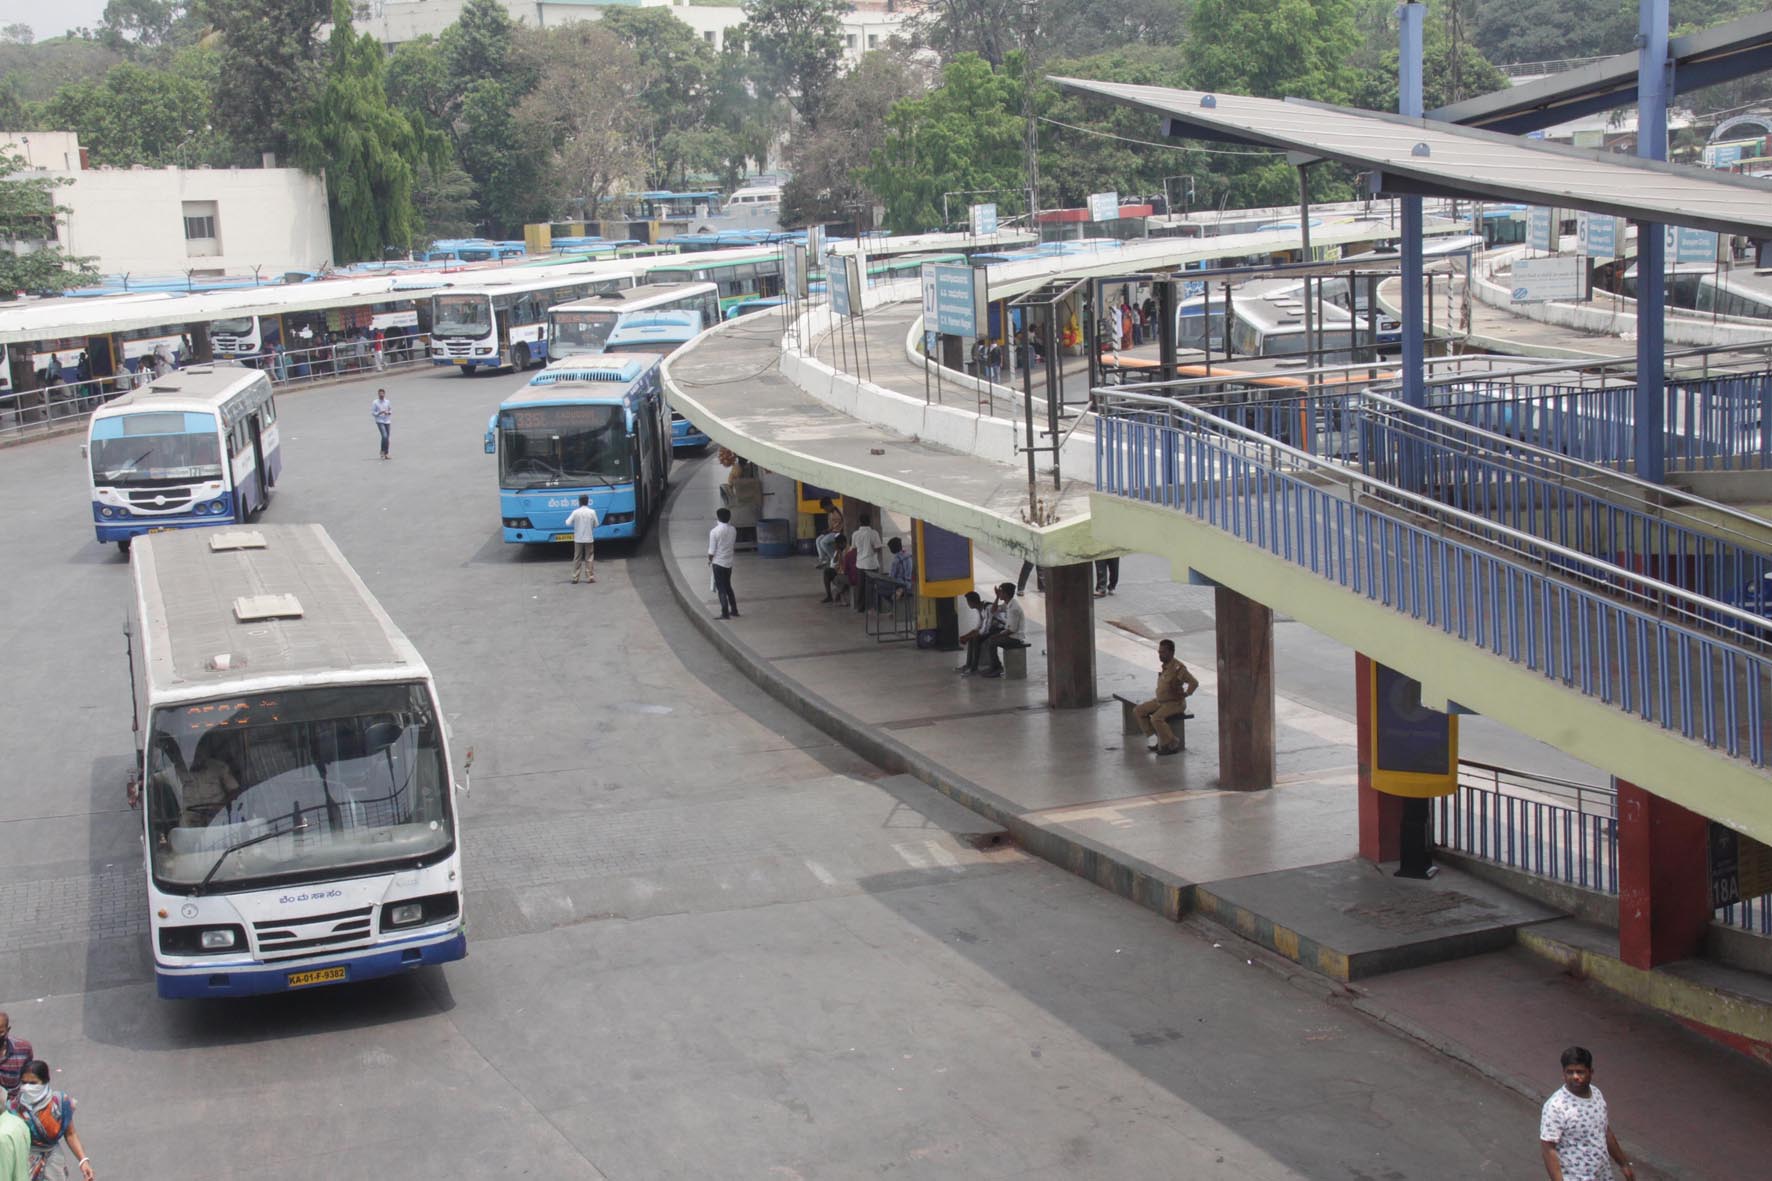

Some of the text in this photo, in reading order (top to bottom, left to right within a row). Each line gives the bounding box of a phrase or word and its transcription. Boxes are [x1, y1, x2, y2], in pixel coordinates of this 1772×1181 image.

[1579, 221, 1586, 241] 6
[1667, 225, 1675, 248] 5
[925, 283, 935, 312] 17
[1713, 877, 1738, 902] 18A
[289, 969, 345, 984] KA-01-F-9382
